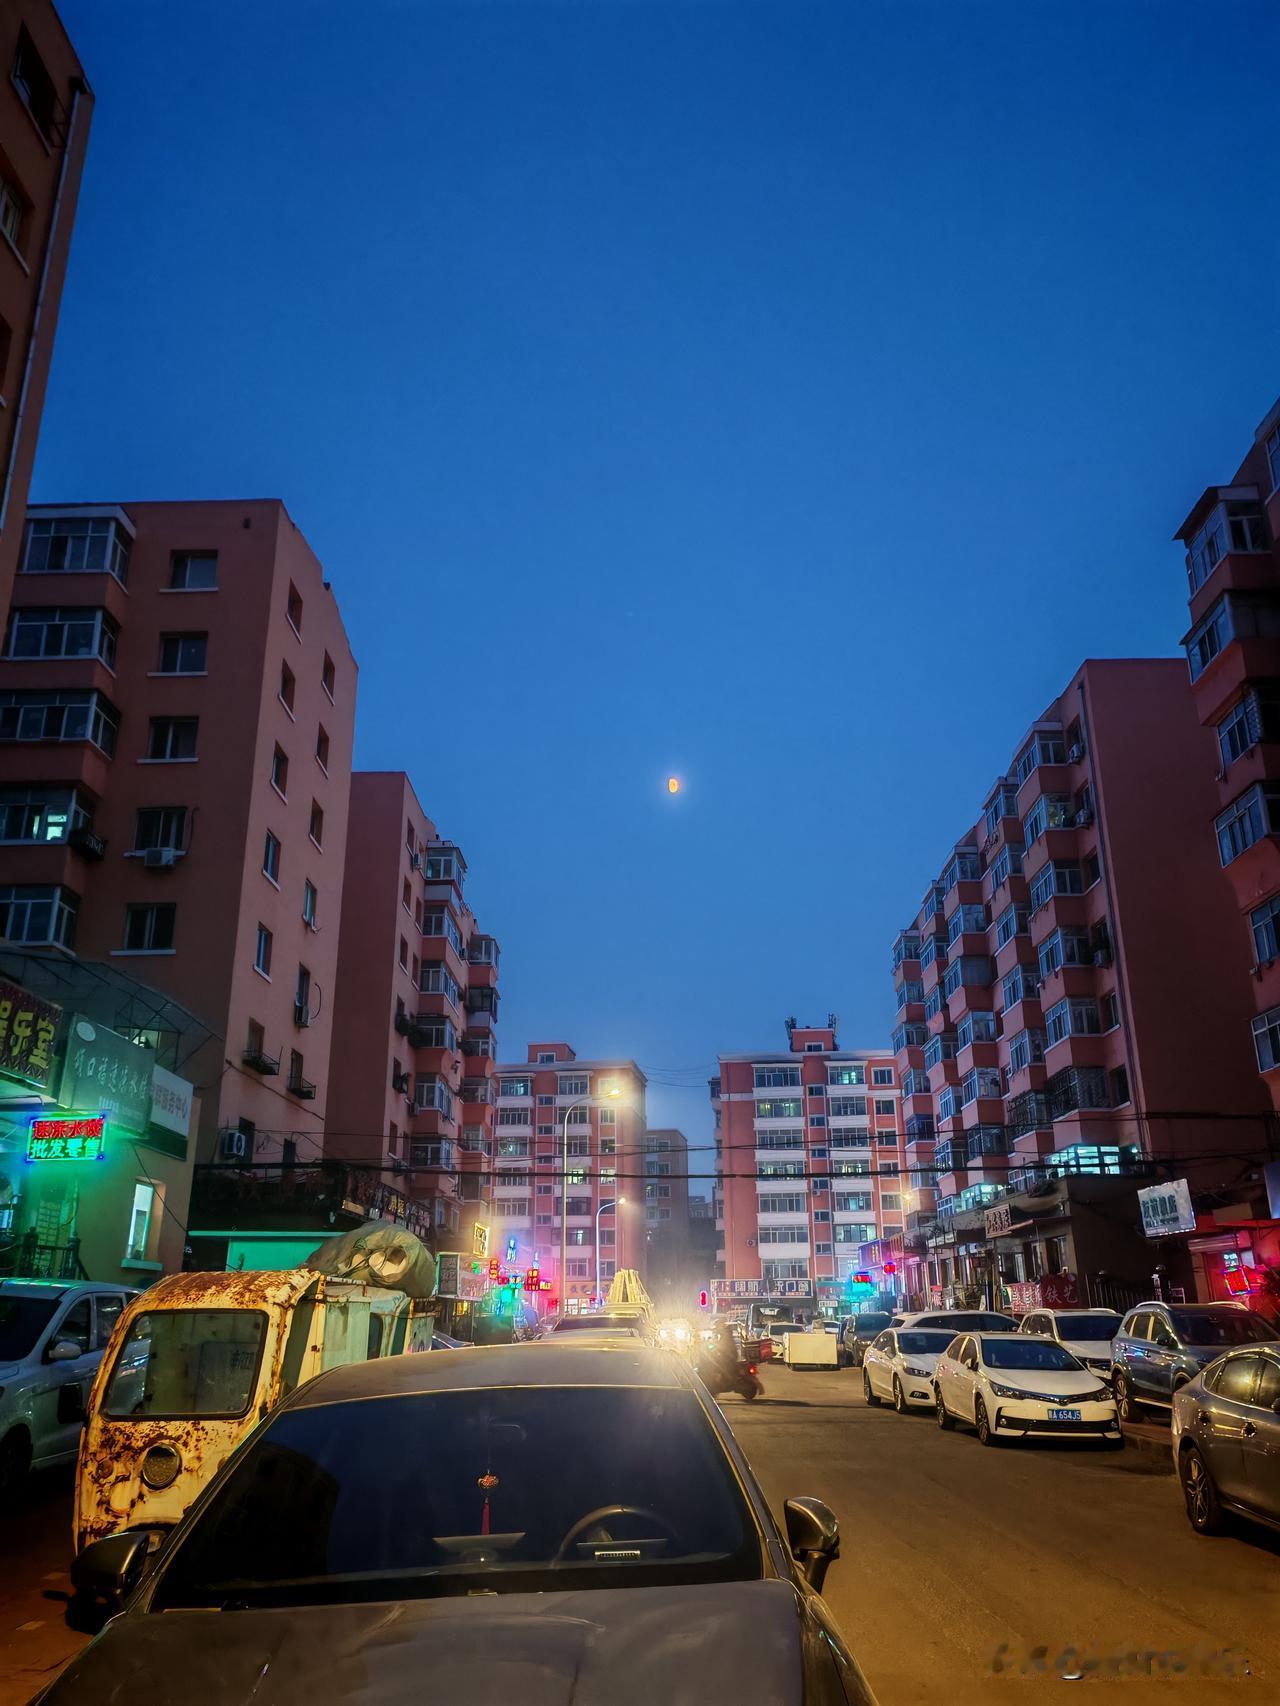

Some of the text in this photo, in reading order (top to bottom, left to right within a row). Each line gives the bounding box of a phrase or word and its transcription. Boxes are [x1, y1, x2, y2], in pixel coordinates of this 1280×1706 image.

[33, 1119, 103, 1137] 速冻水饺
[30, 1138, 100, 1158] 批发零售
